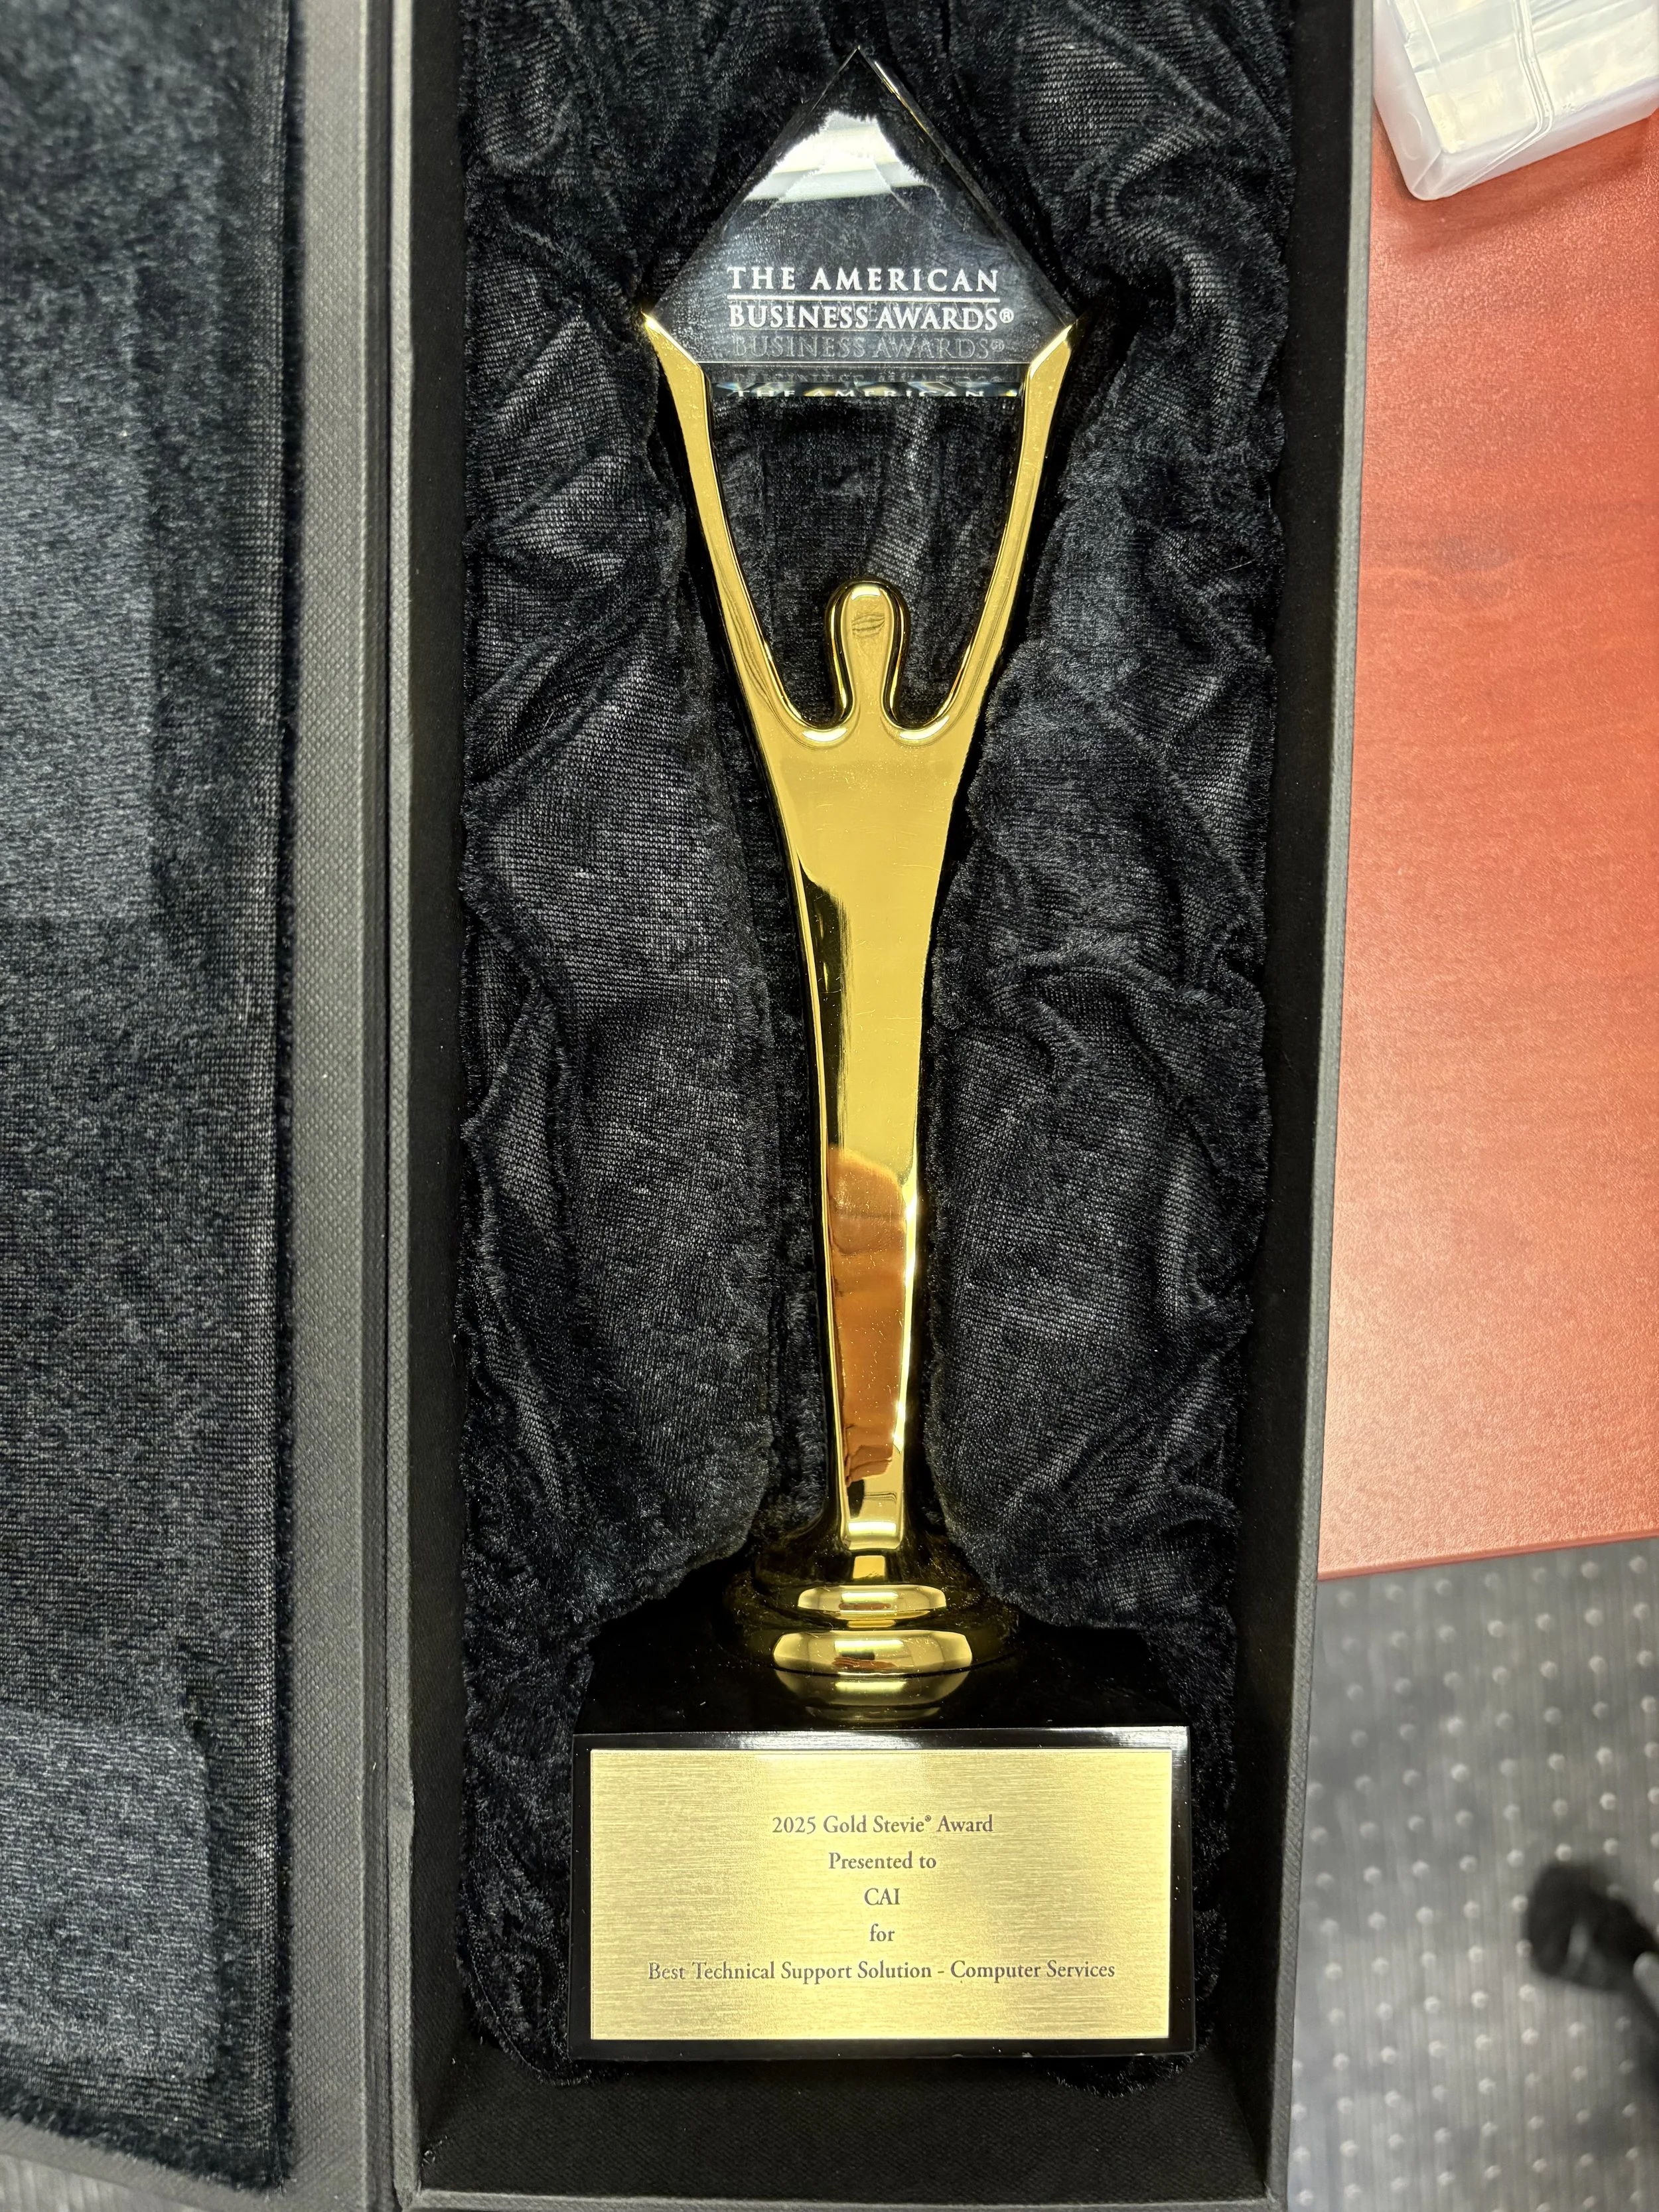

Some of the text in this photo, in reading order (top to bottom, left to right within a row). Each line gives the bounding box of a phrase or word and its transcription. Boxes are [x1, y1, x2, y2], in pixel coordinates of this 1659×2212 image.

[727, 266, 999, 293] THE AMERICAN
[729, 305, 868, 330] BUSINESS
[772, 1816, 816, 1834] 2025
[823, 1815, 867, 1834] Gold
[937, 1815, 993, 1834] Award
[828, 1852, 937, 1870] Presented to
[864, 1888, 901, 1905] CAI
[870, 1925, 895, 1943] for
[648, 1962, 685, 1980] Best
[691, 1961, 775, 1980] Technical
[781, 1961, 852, 1985] Support
[857, 1961, 932, 1979] Solution
[950, 1960, 1041, 1983] Computer
[1046, 1960, 1116, 1978] Services
